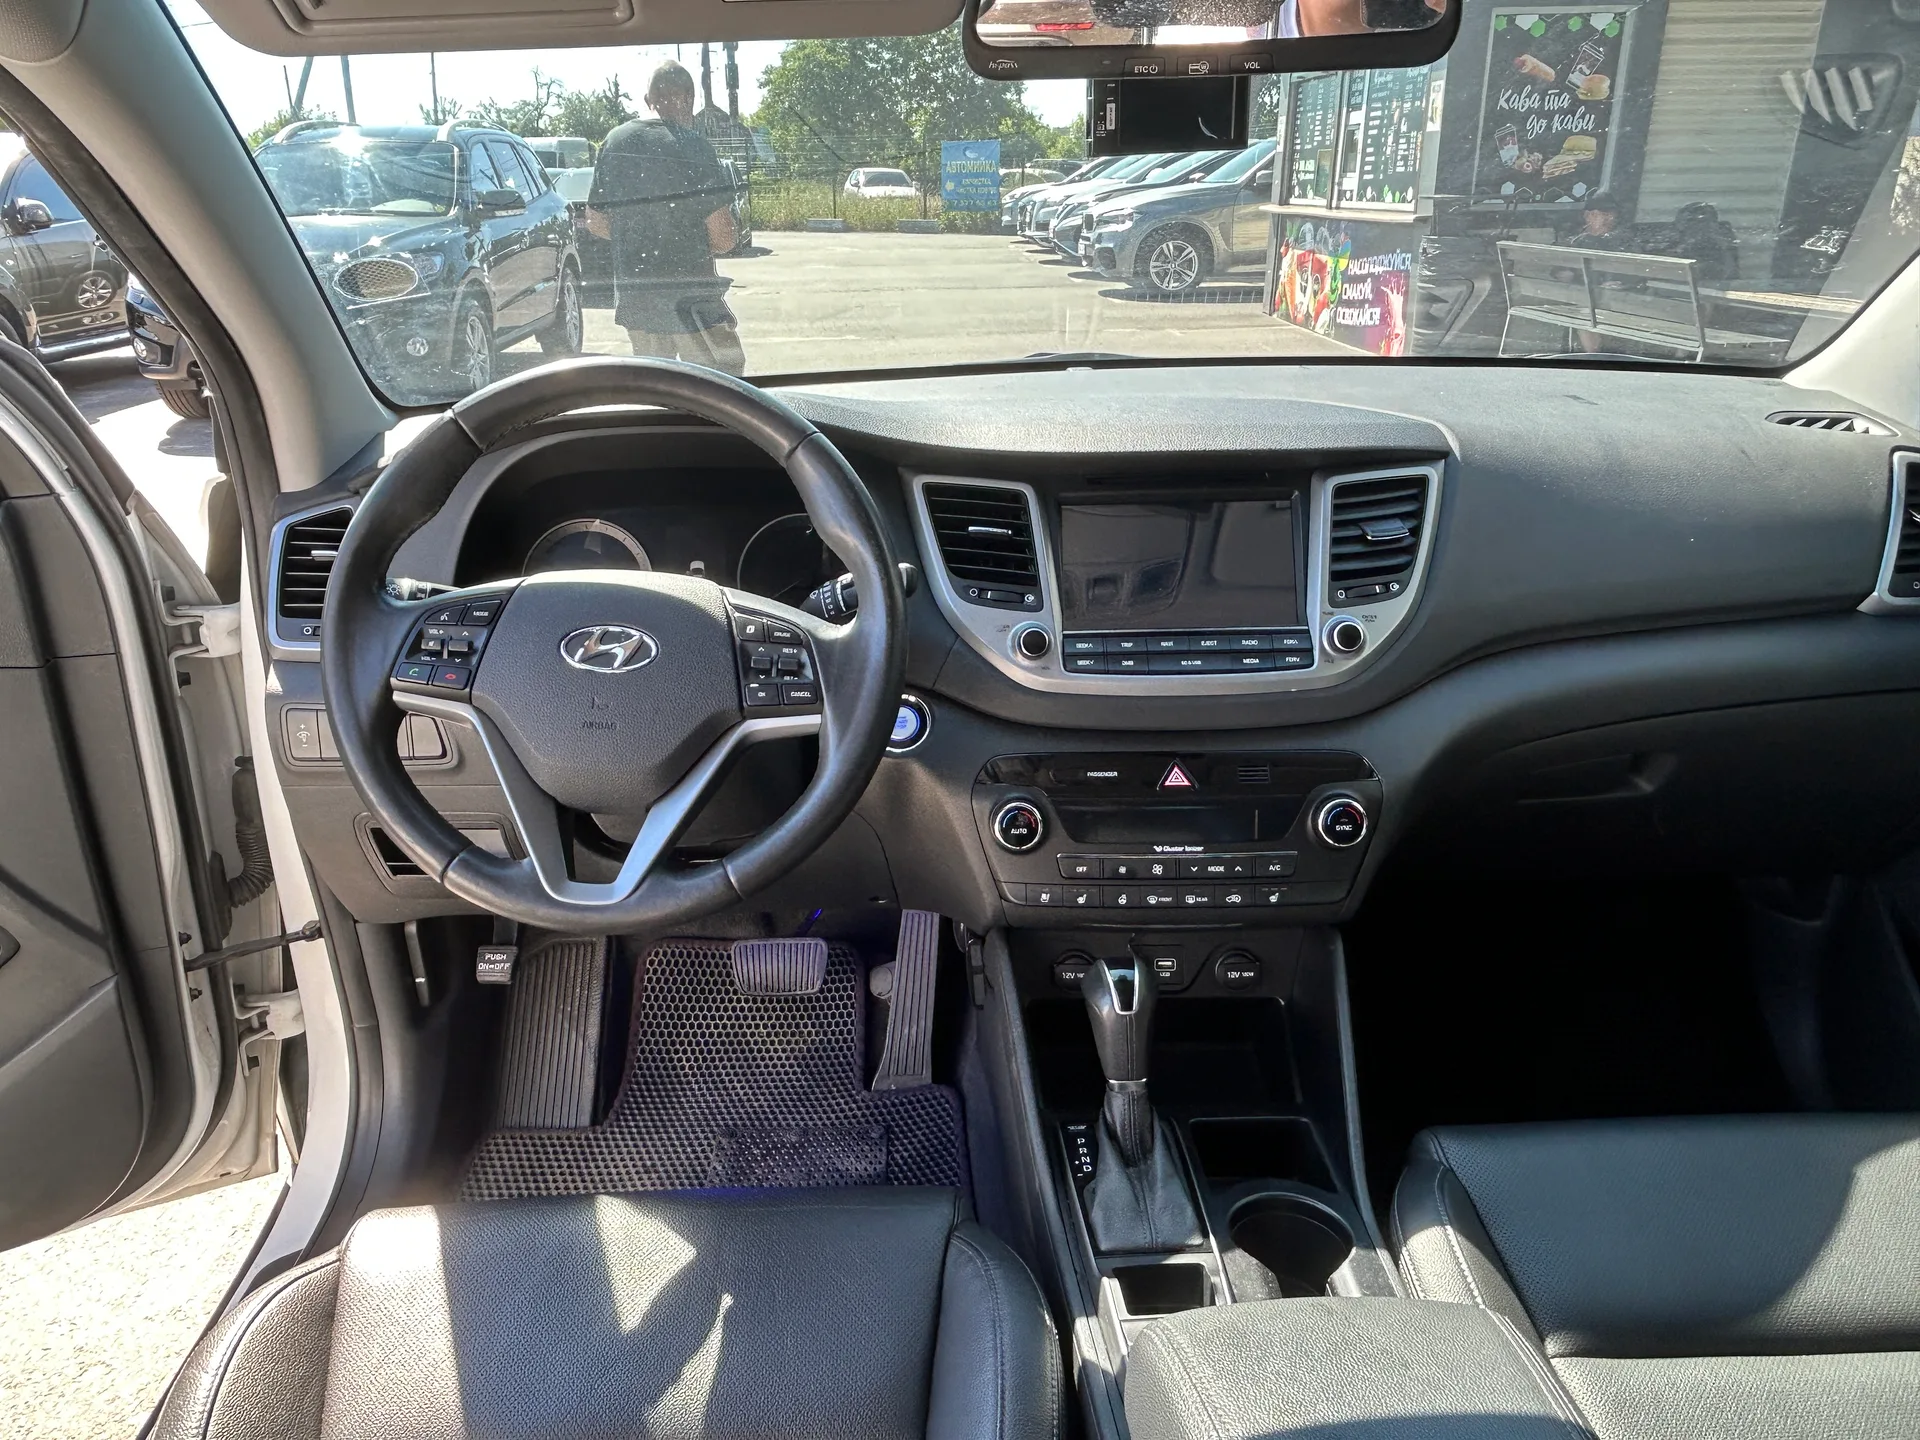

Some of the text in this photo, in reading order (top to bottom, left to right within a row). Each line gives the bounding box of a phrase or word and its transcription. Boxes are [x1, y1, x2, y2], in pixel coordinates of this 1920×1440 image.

[1134, 65, 1149, 73] ETC
[1243, 61, 1261, 69] VOL
[1497, 84, 1571, 112] Кава та
[1526, 105, 1595, 140] до кави
[945, 156, 997, 173] АВТОМИЙКА
[485, 953, 507, 961] PUSH
